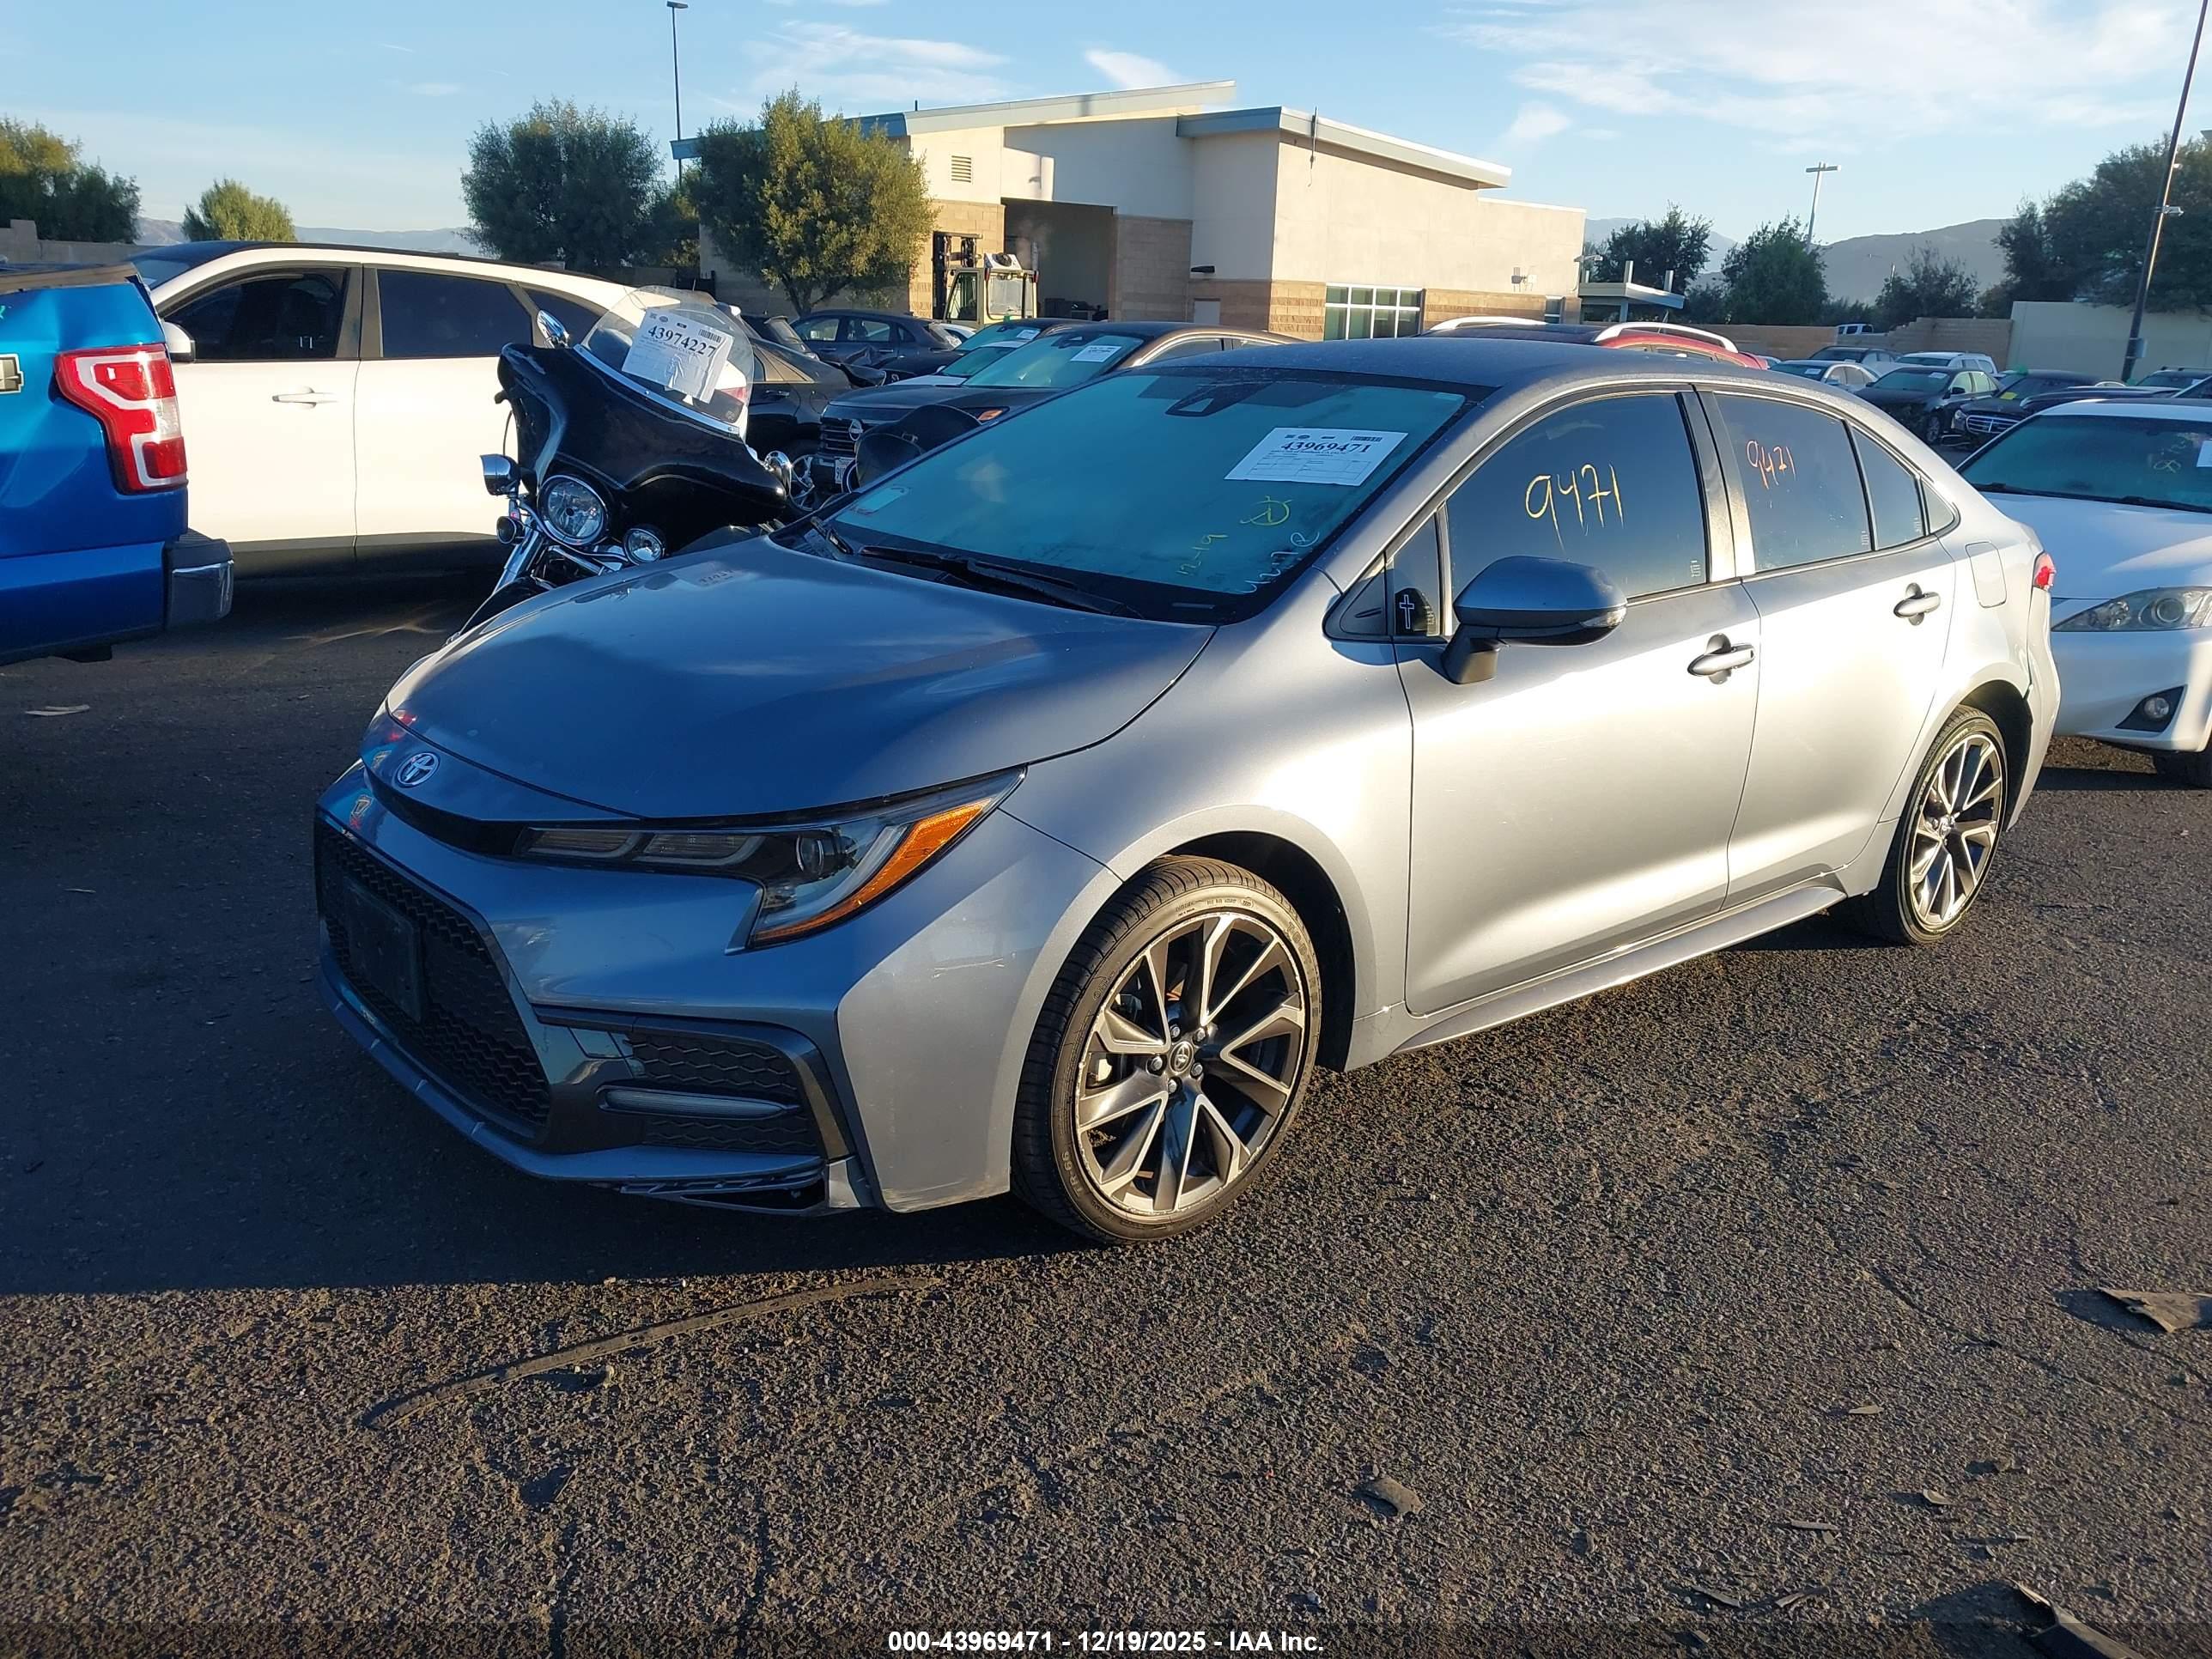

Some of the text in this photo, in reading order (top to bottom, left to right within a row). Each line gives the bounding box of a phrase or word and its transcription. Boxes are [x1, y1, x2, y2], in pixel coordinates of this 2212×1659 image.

[648, 325, 716, 357] 43974227
[1281, 441, 1371, 453] 43969471
[1525, 461, 1625, 555] 9471
